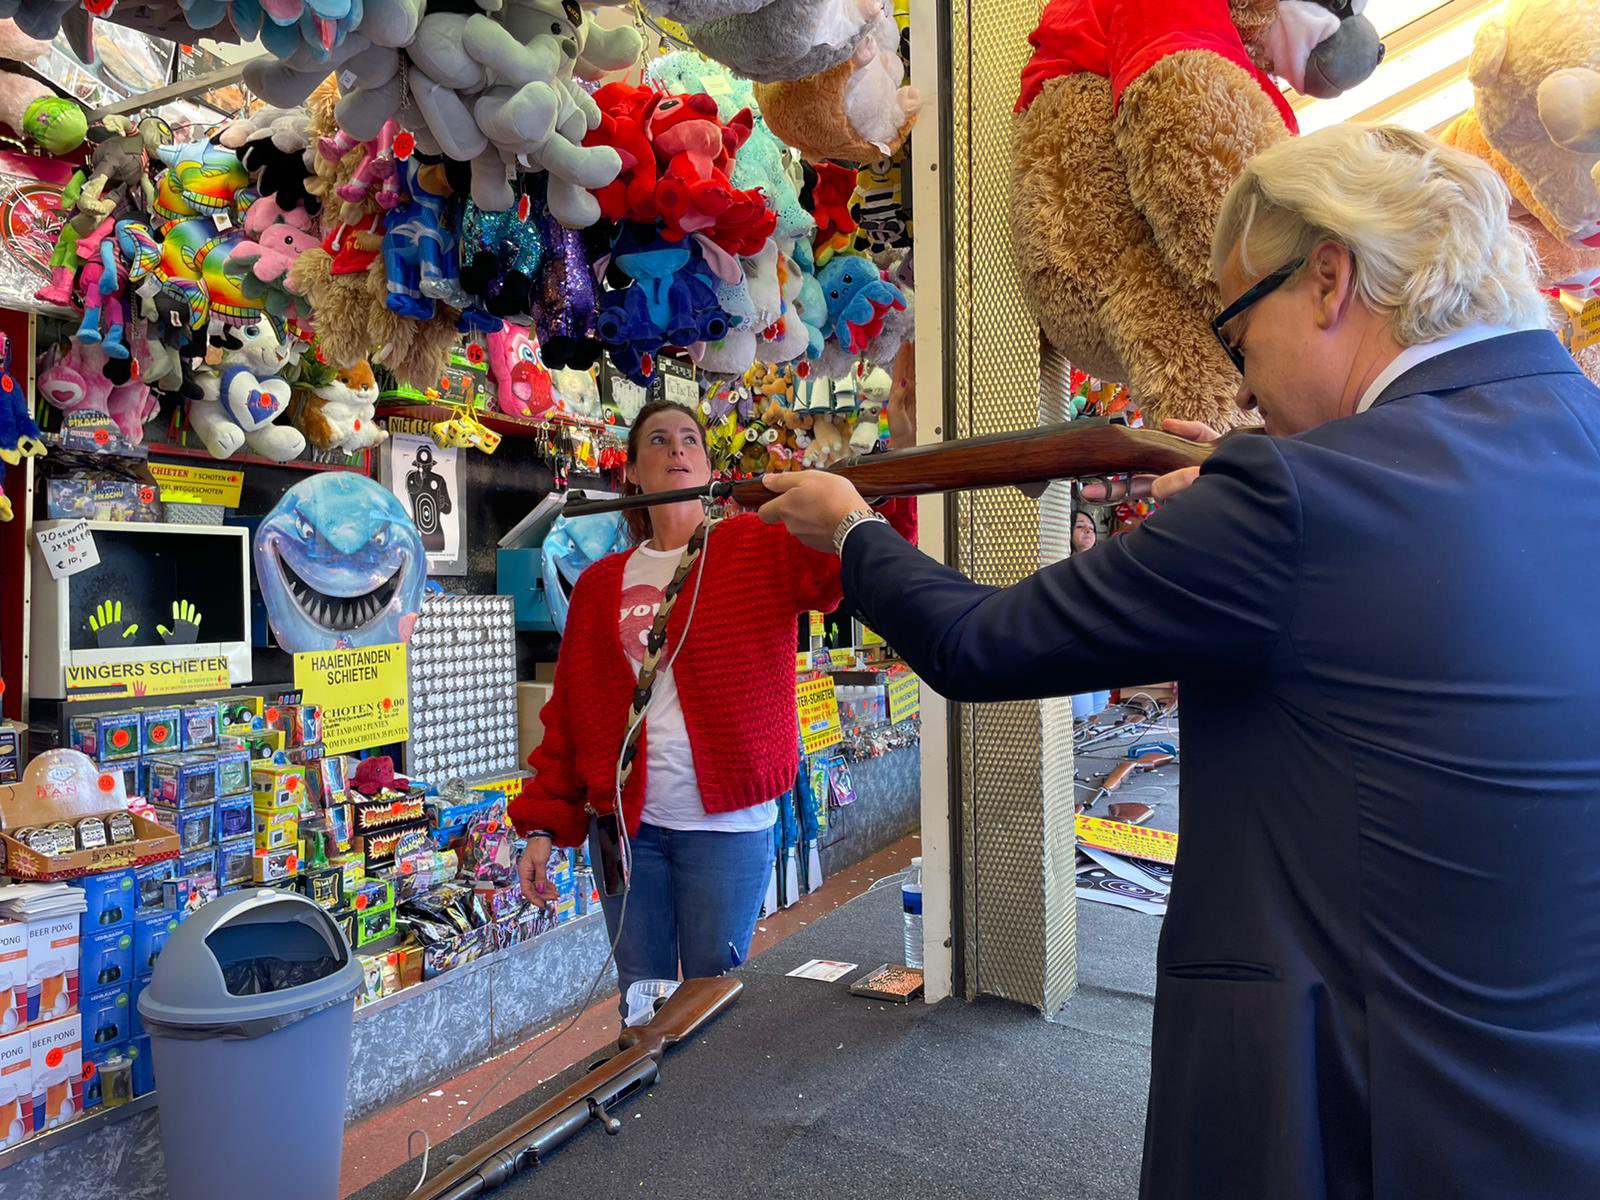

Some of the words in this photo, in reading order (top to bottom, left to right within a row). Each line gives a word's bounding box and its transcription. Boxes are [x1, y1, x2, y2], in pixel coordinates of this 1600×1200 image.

[149, 465, 190, 479] CHIETEN
[141, 491, 153, 500] 20
[40, 531, 56, 543] 20
[311, 649, 391, 671] HAAIENTANDEN
[69, 663, 145, 681] VINGERS
[149, 658, 228, 676] SCHIETEN
[327, 666, 378, 686] SCHIETEN
[797, 689, 836, 708] TER-SCHIETEN
[323, 702, 374, 719] CHOTEN
[153, 729, 165, 738] 20
[1100, 820, 1177, 842] SCHIE
[29, 926, 50, 938] BEER
[51, 922, 74, 935] PONG
[32, 1036, 53, 1049] BEER
[53, 1028, 76, 1042] PONG
[1, 1046, 24, 1060] PONG
